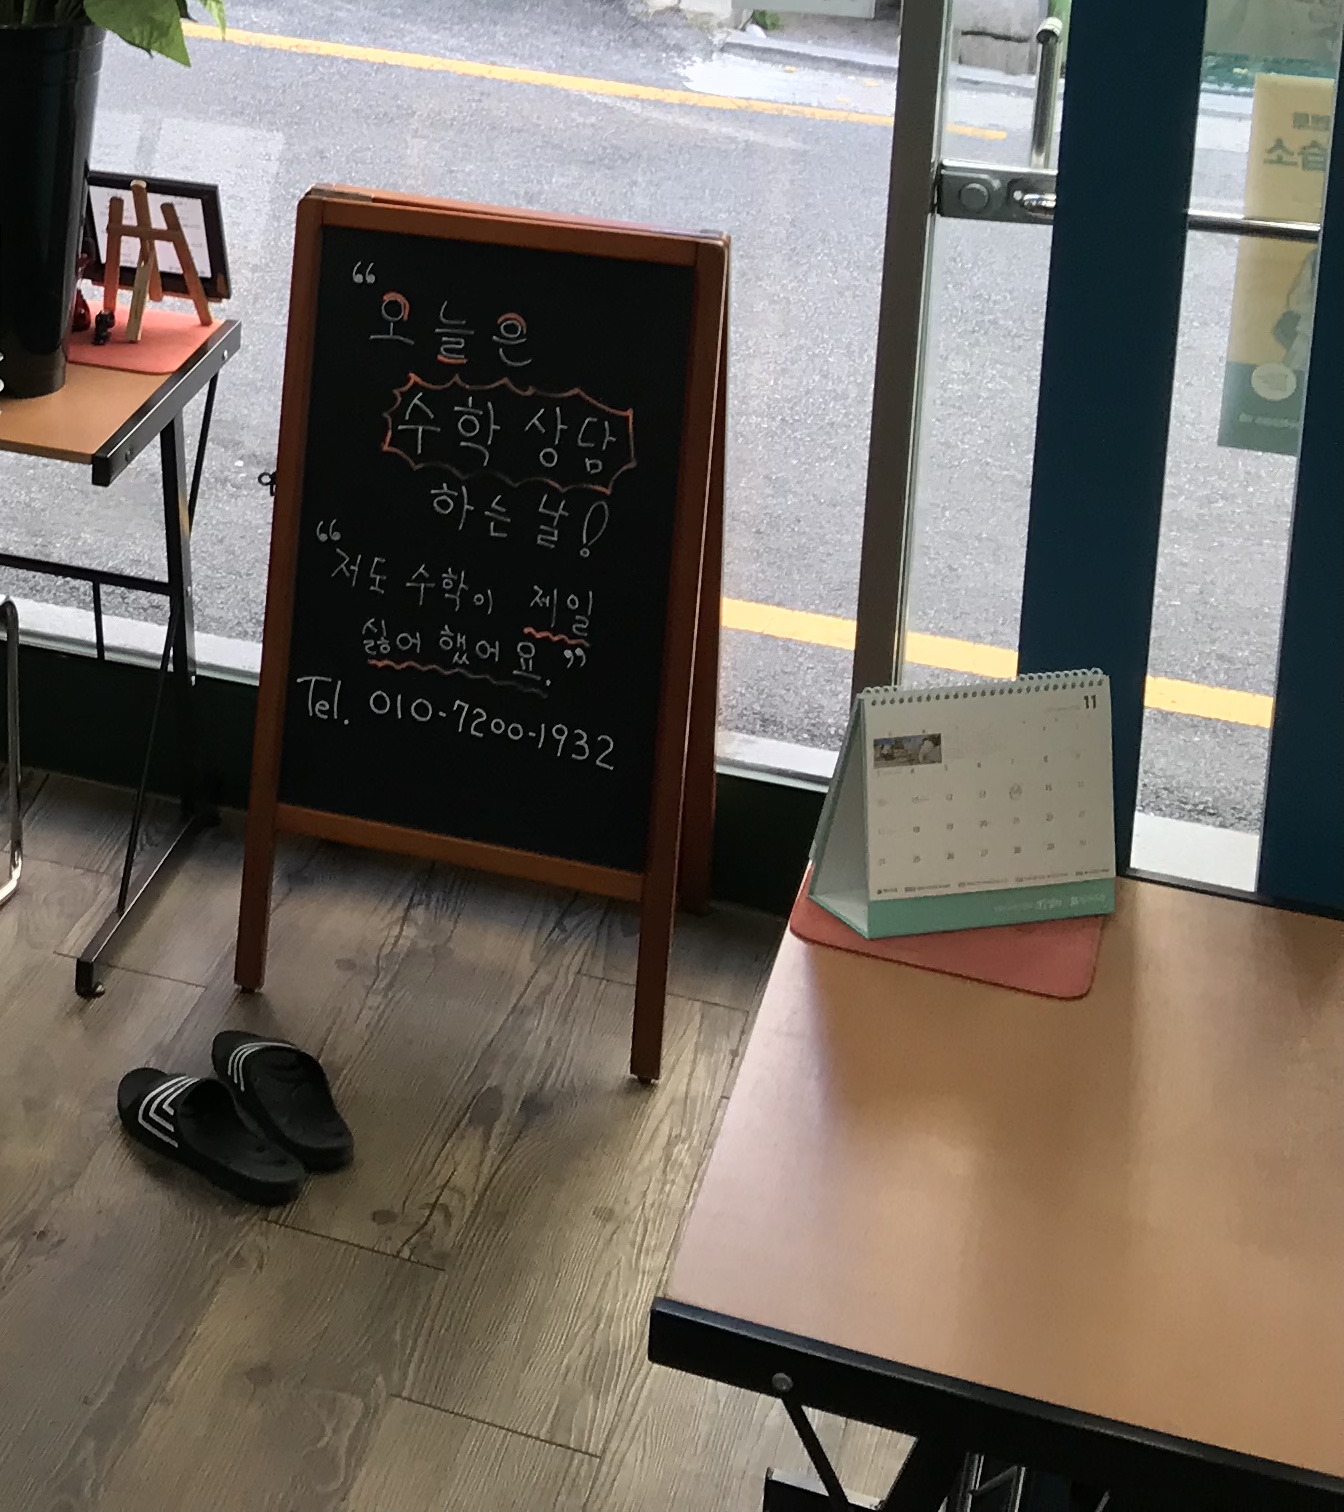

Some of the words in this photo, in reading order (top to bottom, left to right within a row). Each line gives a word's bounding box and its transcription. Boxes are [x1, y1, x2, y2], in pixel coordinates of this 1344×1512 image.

[396, 392, 500, 467] 수학
[524, 406, 615, 475] 상담
[430, 484, 511, 538] 하는
[404, 564, 494, 616] 수학이
[529, 584, 595, 637] 제일
[296, 673, 351, 726] Tel.
[369, 690, 615, 772] 010-7200-1932
[1083, 694, 1098, 710] 11
